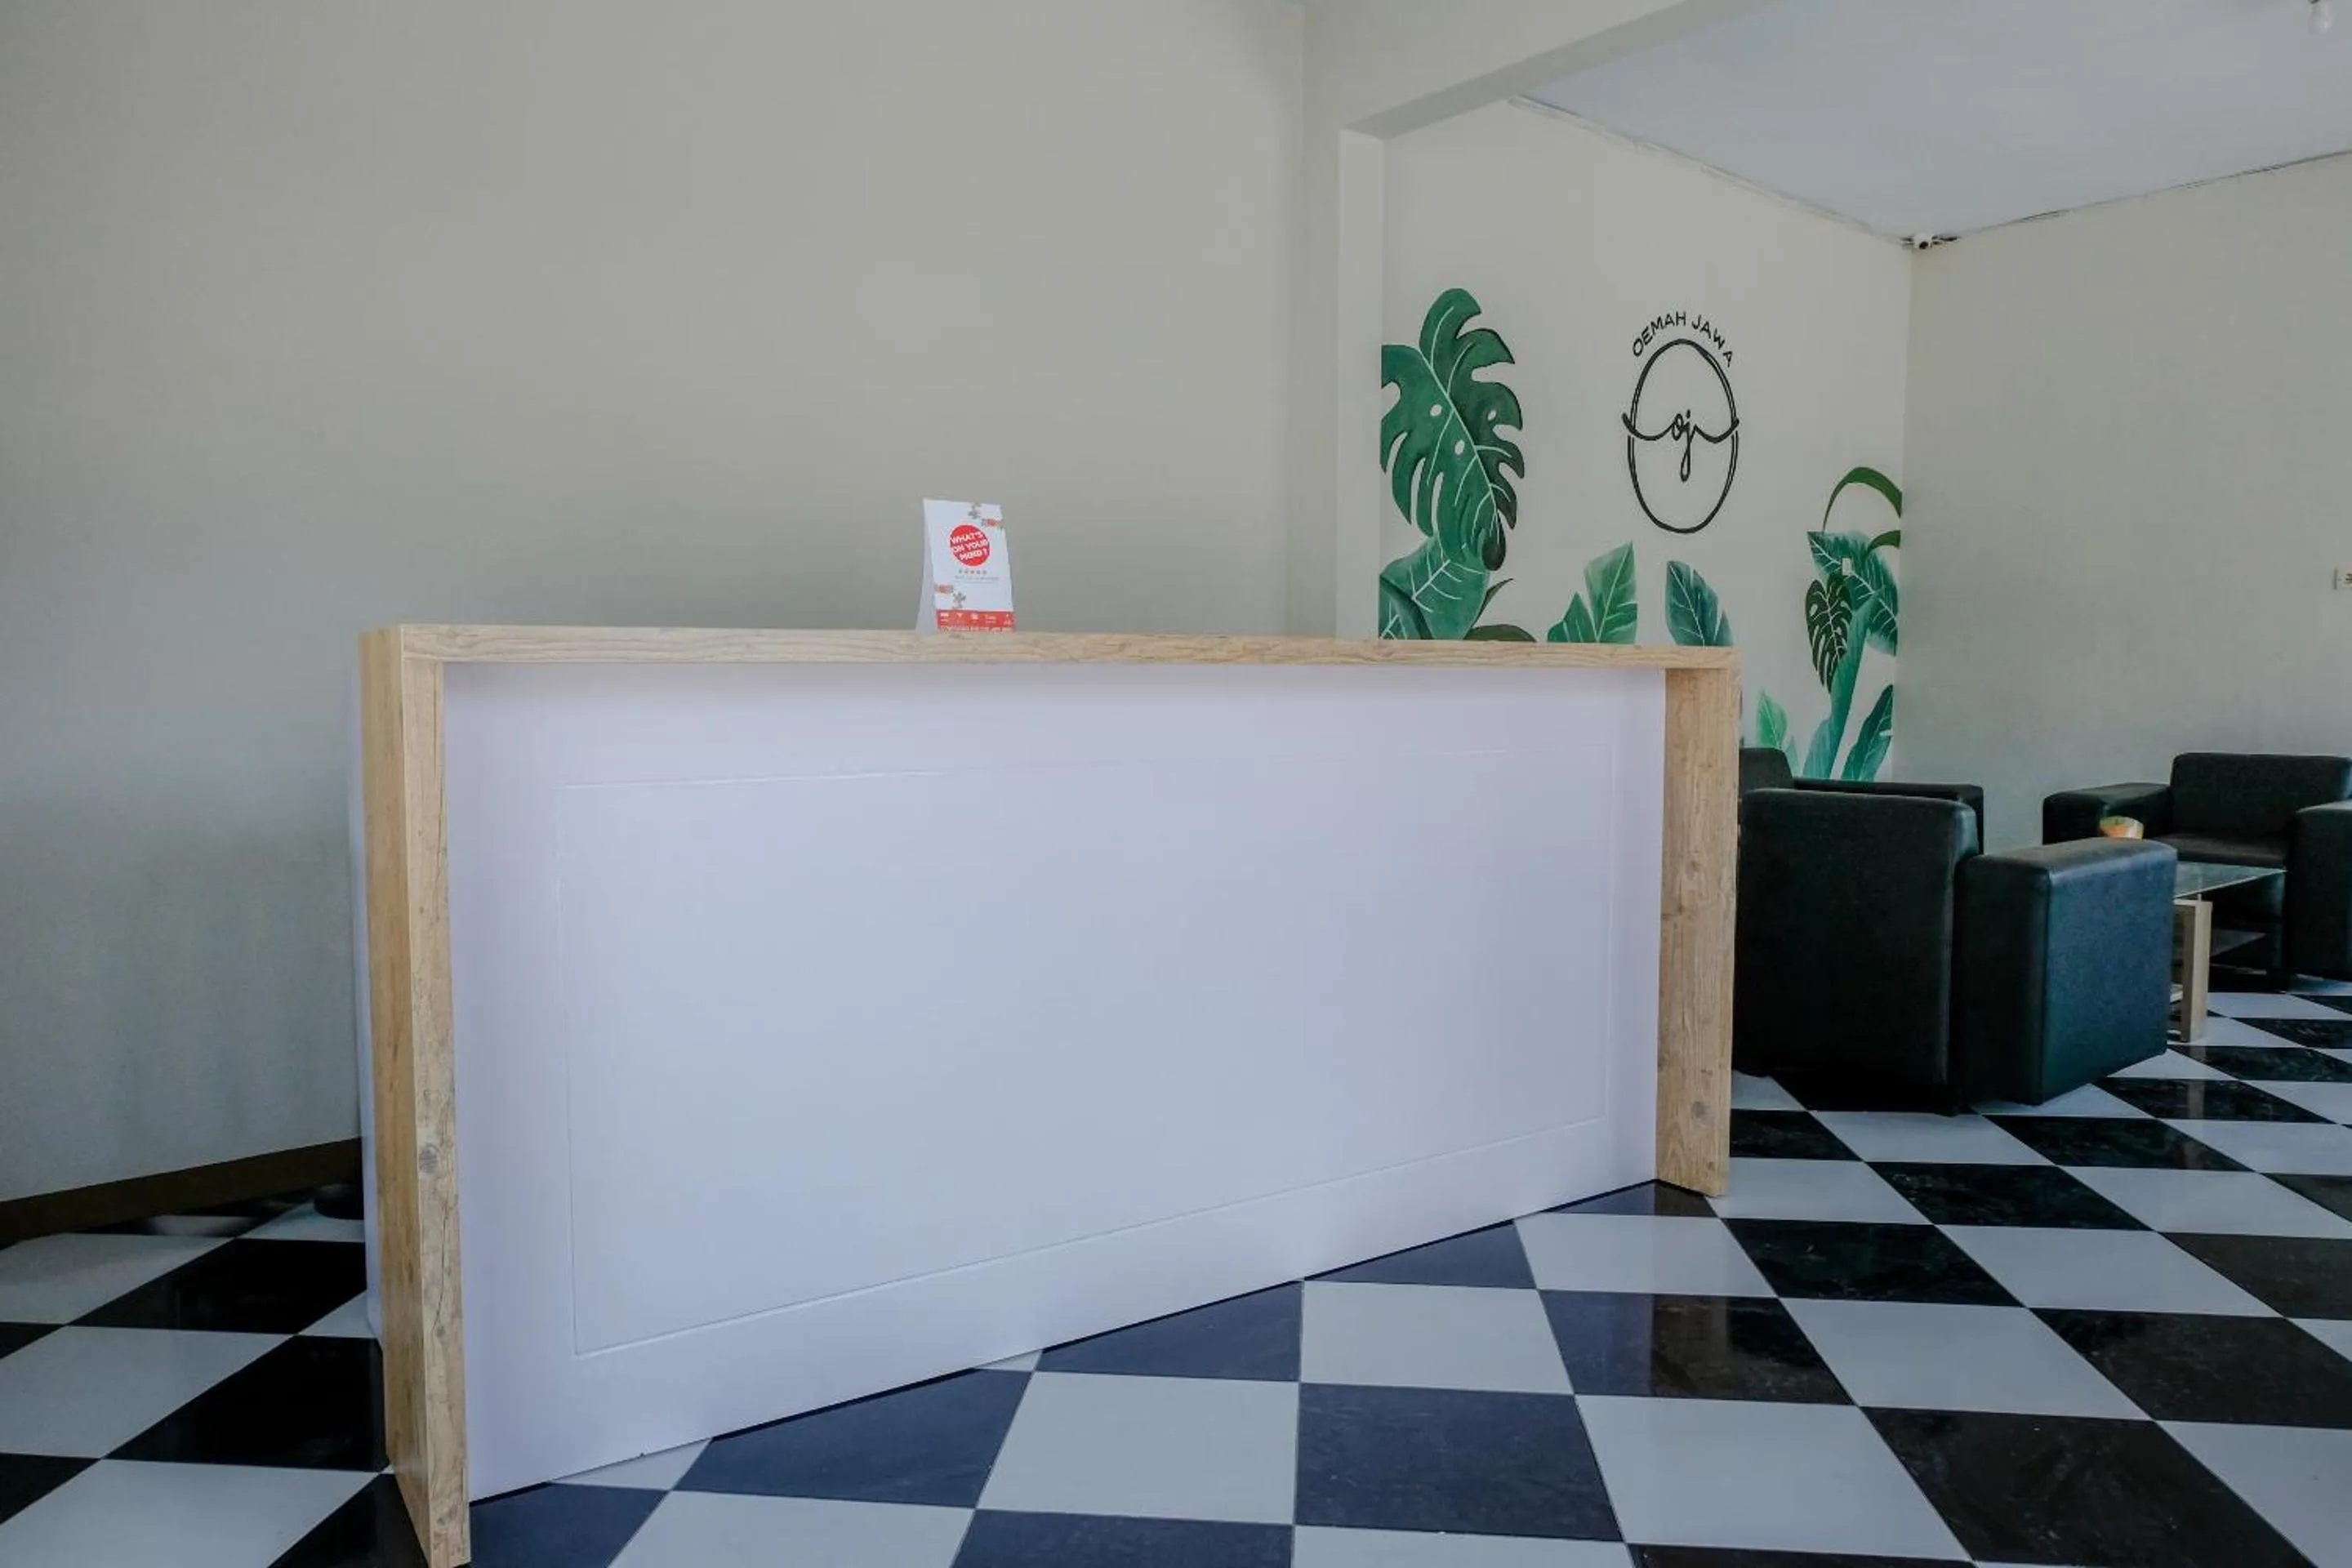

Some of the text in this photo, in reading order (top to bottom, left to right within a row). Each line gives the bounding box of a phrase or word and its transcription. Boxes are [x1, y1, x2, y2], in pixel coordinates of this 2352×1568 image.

[1633, 310, 1733, 368] OEMAH JAWA
[951, 532, 983, 544] WHAT'S
[953, 539, 988, 553] ON YOUR
